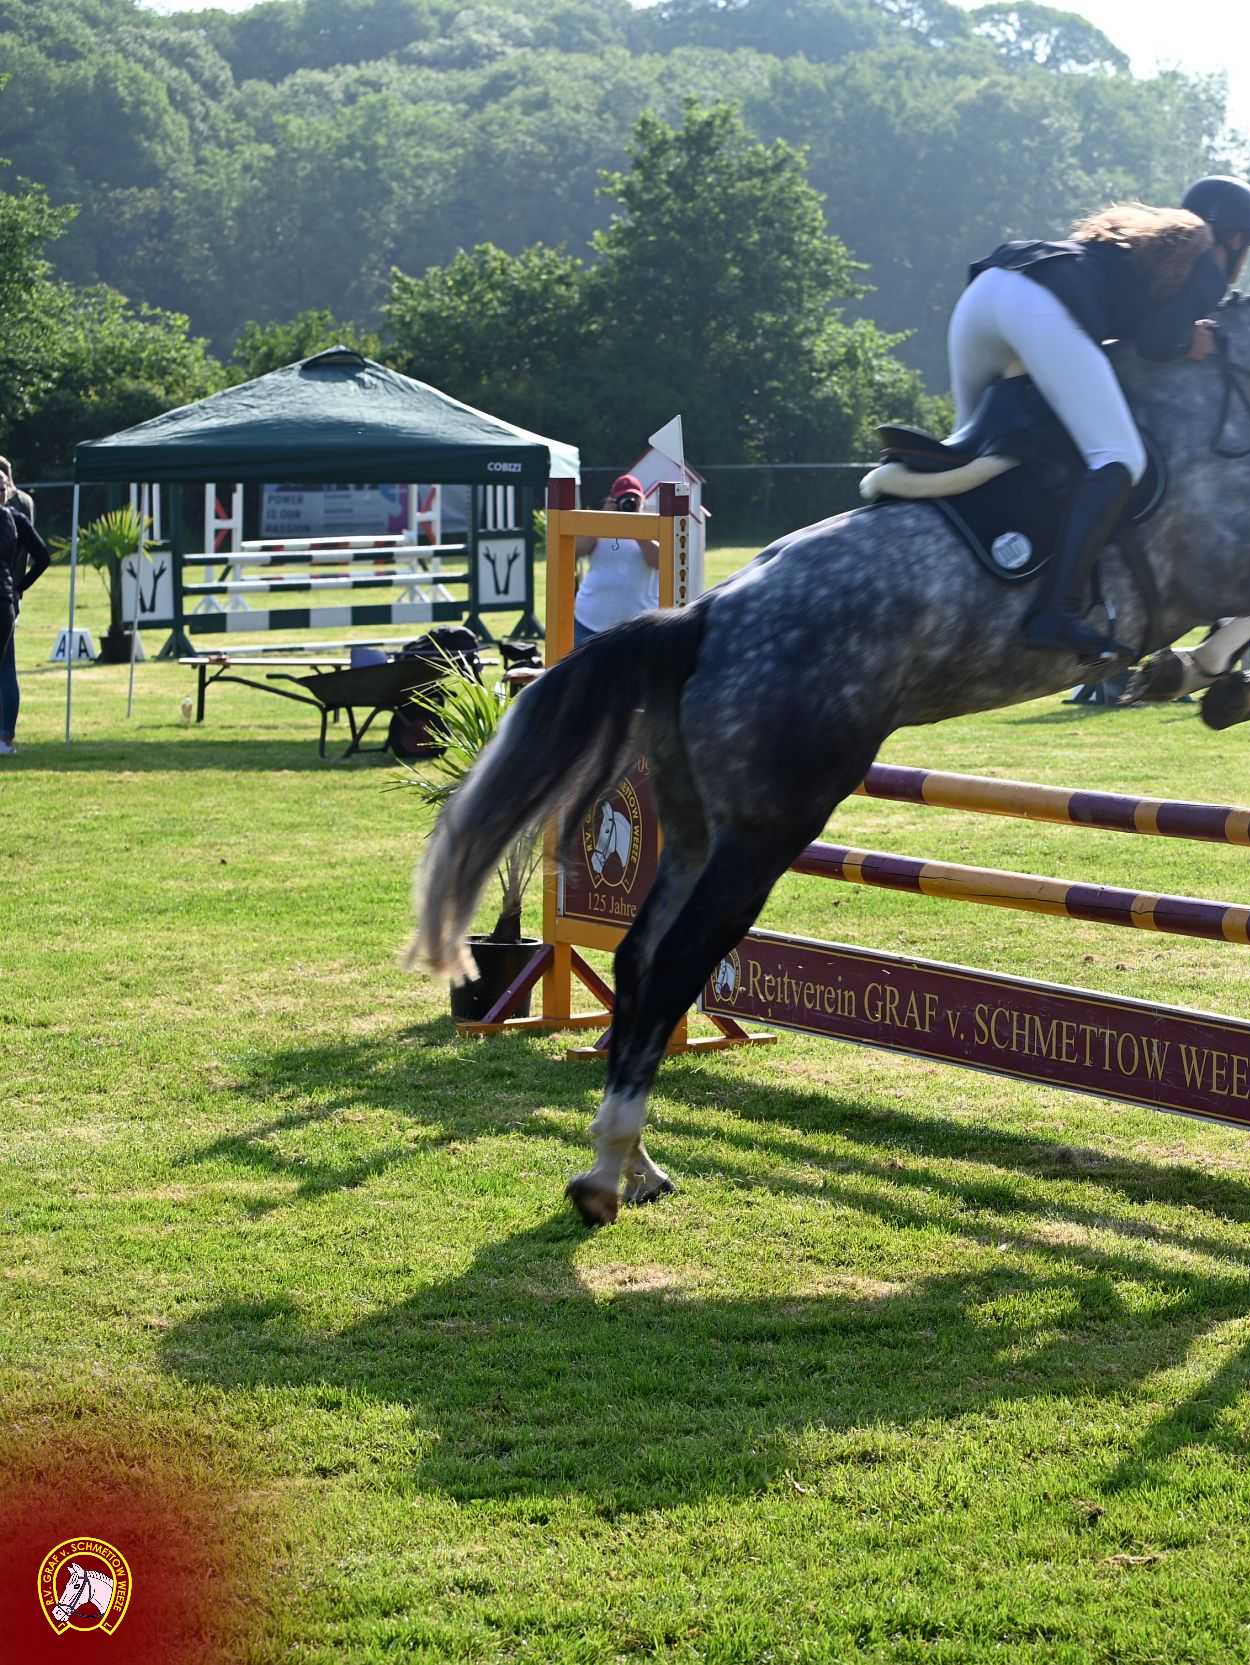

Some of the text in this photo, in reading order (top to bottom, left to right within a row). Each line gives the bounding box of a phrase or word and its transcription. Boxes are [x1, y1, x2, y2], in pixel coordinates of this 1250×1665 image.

[55, 634, 66, 658] A
[78, 634, 89, 659] A
[588, 892, 638, 918] 125 Jahre
[747, 959, 857, 1018] Reitverein
[864, 982, 939, 1033] GRAF
[946, 1009, 965, 1041] v.
[974, 1003, 1170, 1081] SCHMETTOW
